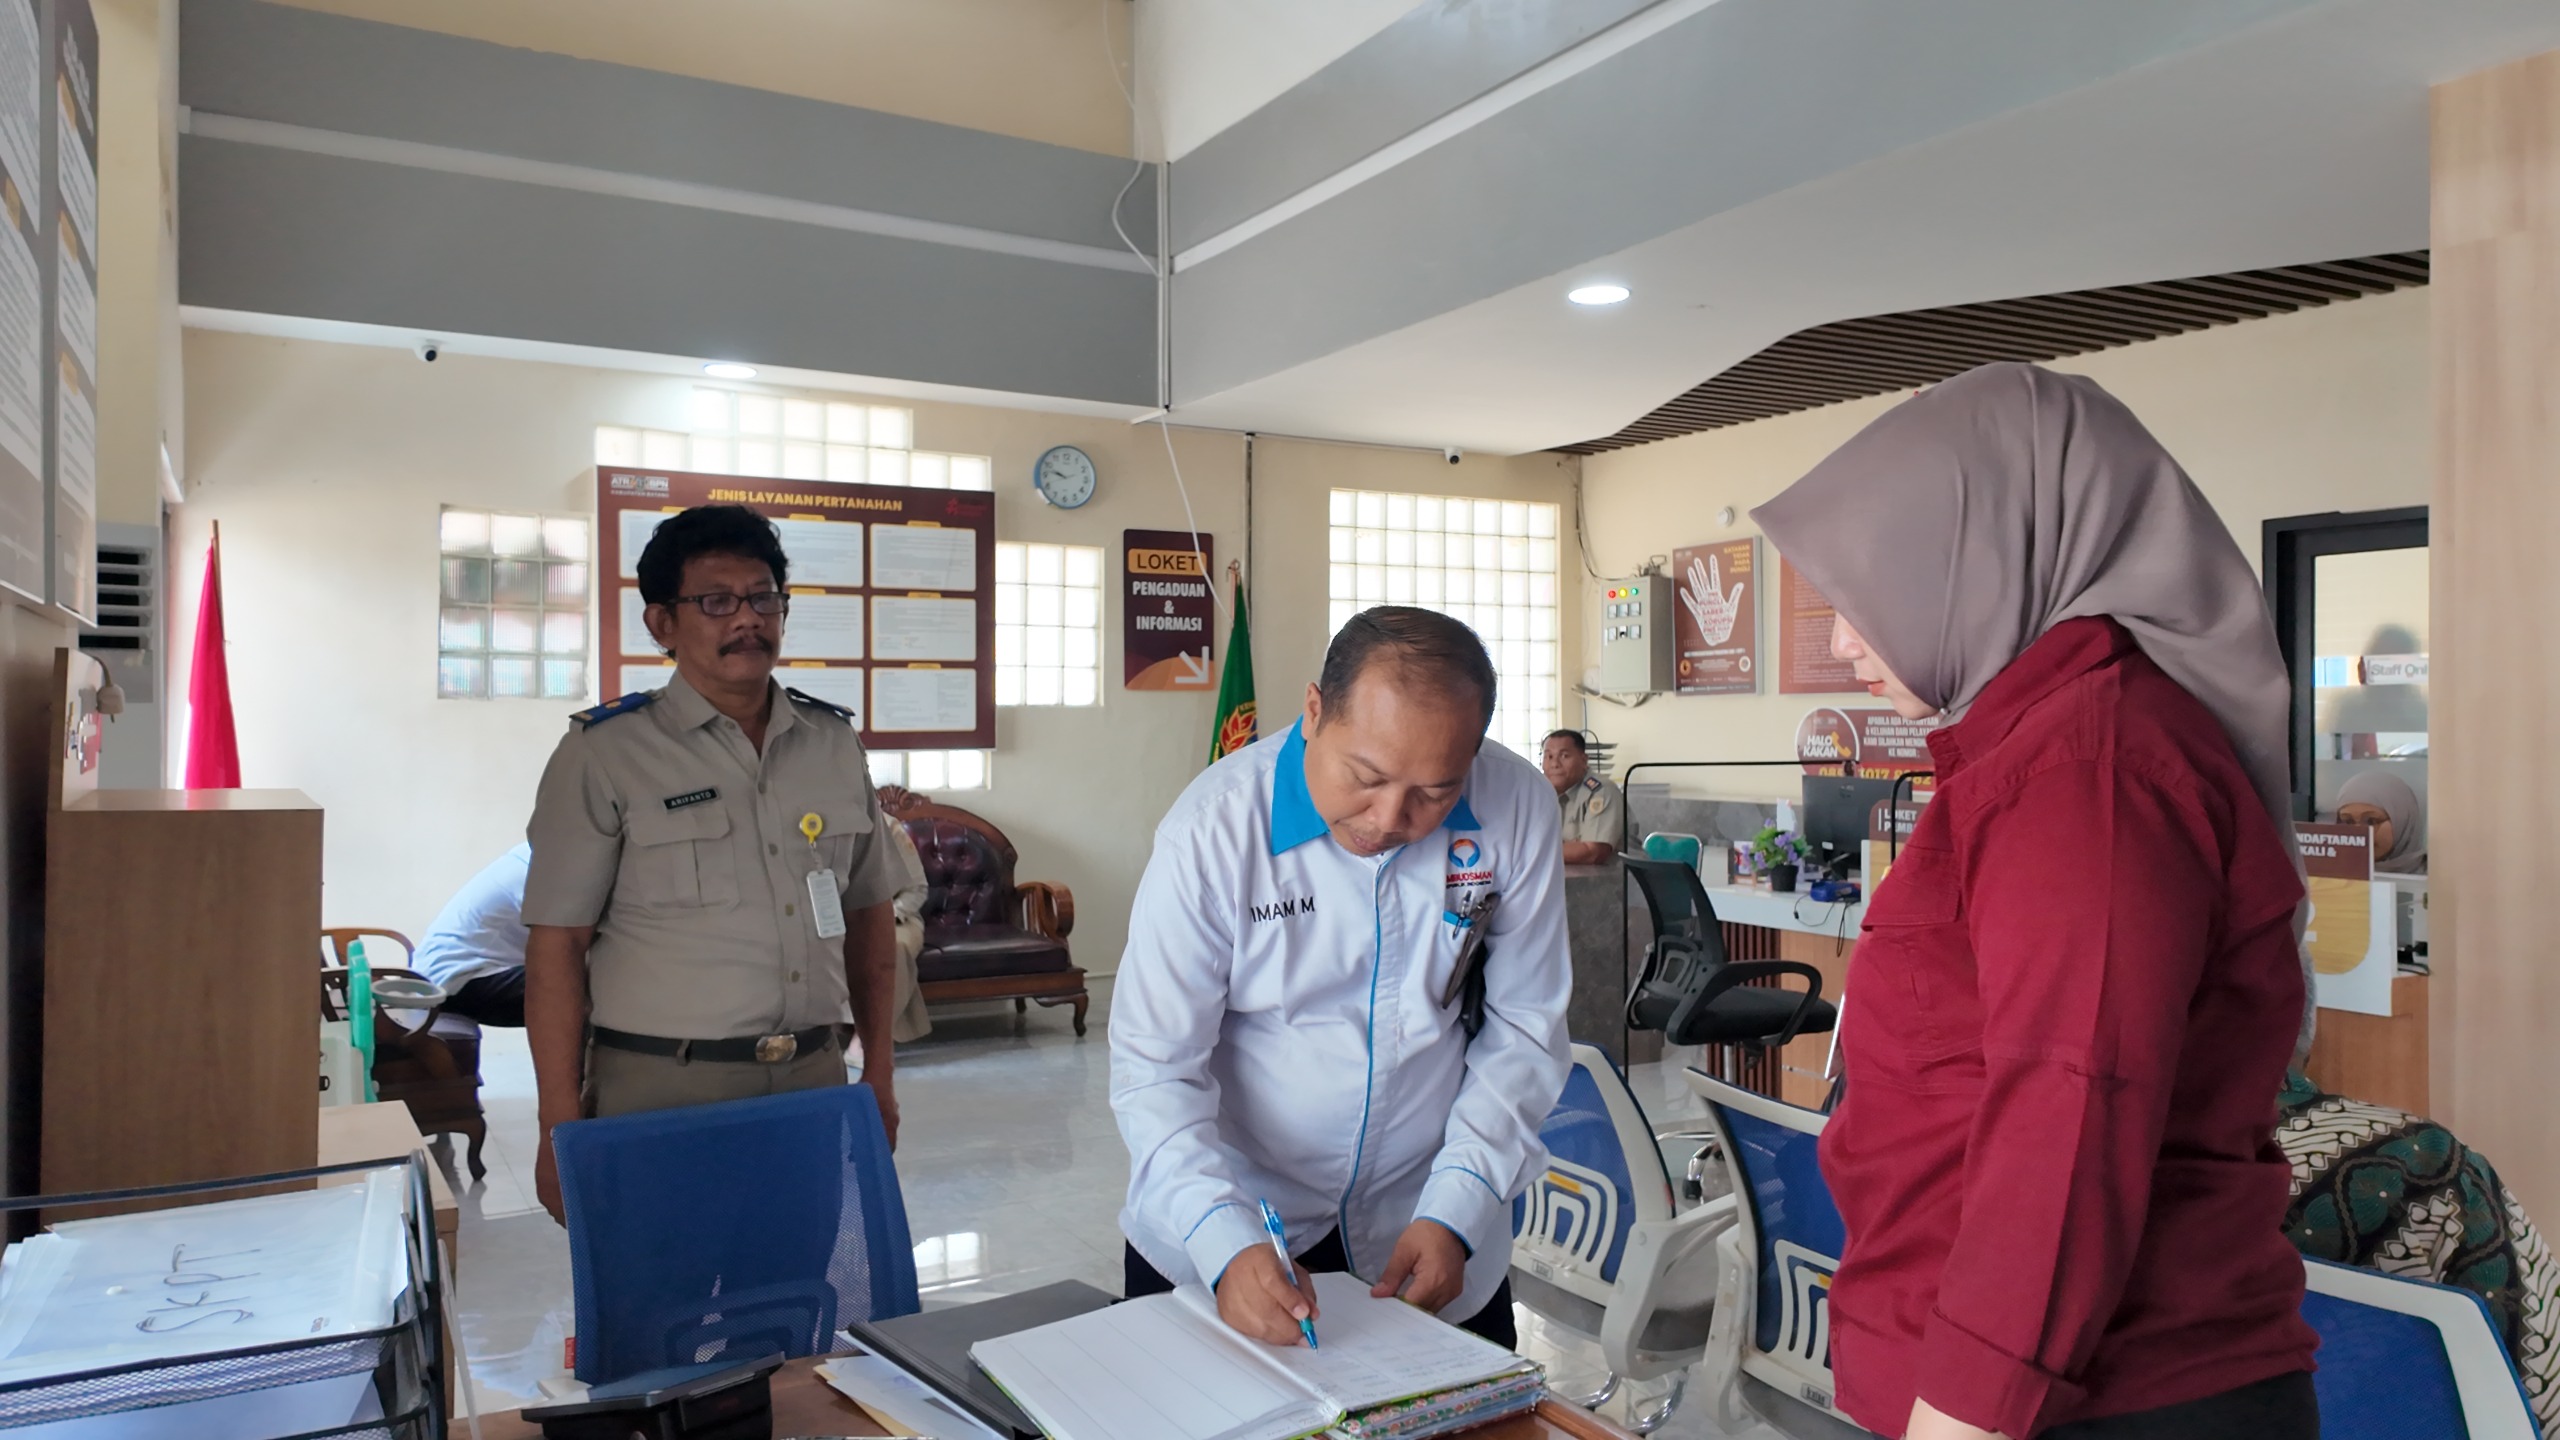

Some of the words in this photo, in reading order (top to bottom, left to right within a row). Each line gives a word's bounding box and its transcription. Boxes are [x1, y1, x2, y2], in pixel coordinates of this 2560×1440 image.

[708, 488, 747, 501] JENIS
[748, 491, 813, 507] LAYANAN
[815, 494, 903, 512] PERTANAHAN
[1137, 553, 1198, 571] LOKET
[1132, 581, 1206, 598] PENGADUAN
[1163, 600, 1175, 614] &
[1136, 616, 1202, 632] INFORMASI
[2371, 663, 2401, 675] Staff
[2405, 663, 2428, 676] Onl
[1807, 735, 1833, 746] HALO
[1803, 745, 1838, 758] KAKAN
[2295, 832, 2366, 847] NDAFTARAN
[2327, 846, 2337, 858] &
[1446, 871, 1493, 883] MBUDSMAN
[1250, 898, 1296, 923] IMAM
[1301, 896, 1316, 913] M
